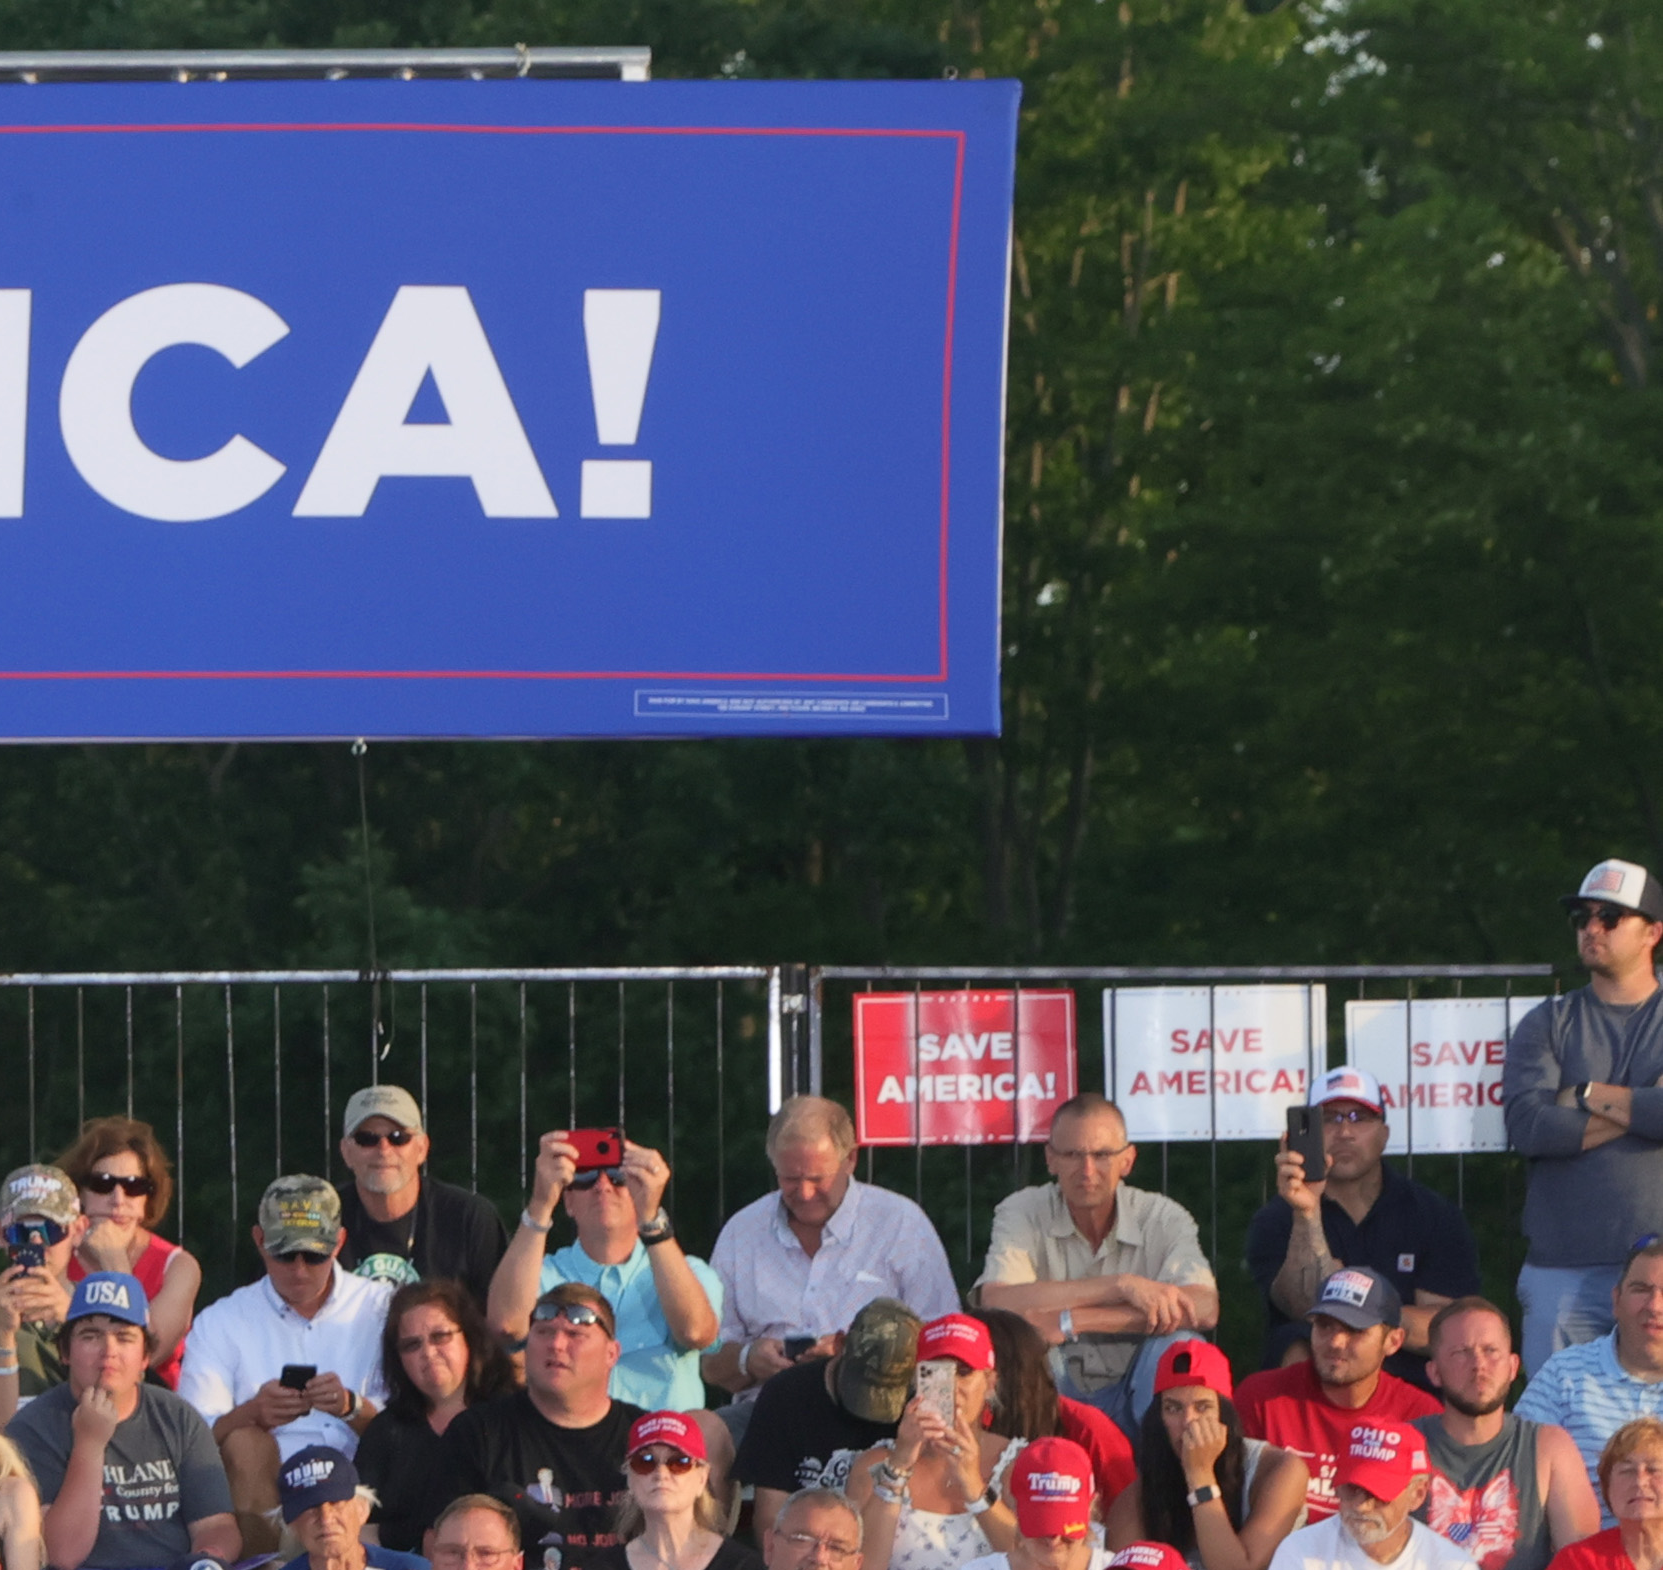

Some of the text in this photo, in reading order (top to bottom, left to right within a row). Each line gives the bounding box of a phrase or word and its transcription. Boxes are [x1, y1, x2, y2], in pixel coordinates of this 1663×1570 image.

[918, 1030, 1014, 1062] SAVE
[1170, 1027, 1265, 1055] SAVE
[1411, 1041, 1504, 1068] SAVE
[876, 1072, 1057, 1105] AMERICA!
[1129, 1068, 1307, 1097] AMERICA!
[10, 1175, 62, 1193] TRUMP
[85, 1281, 130, 1310] USA
[1351, 1426, 1402, 1446] OHIO
[1350, 1444, 1396, 1462] TRUMP
[286, 1461, 335, 1487] TRUMP
[1027, 1472, 1082, 1495] Trump
[115, 1483, 157, 1499] County
